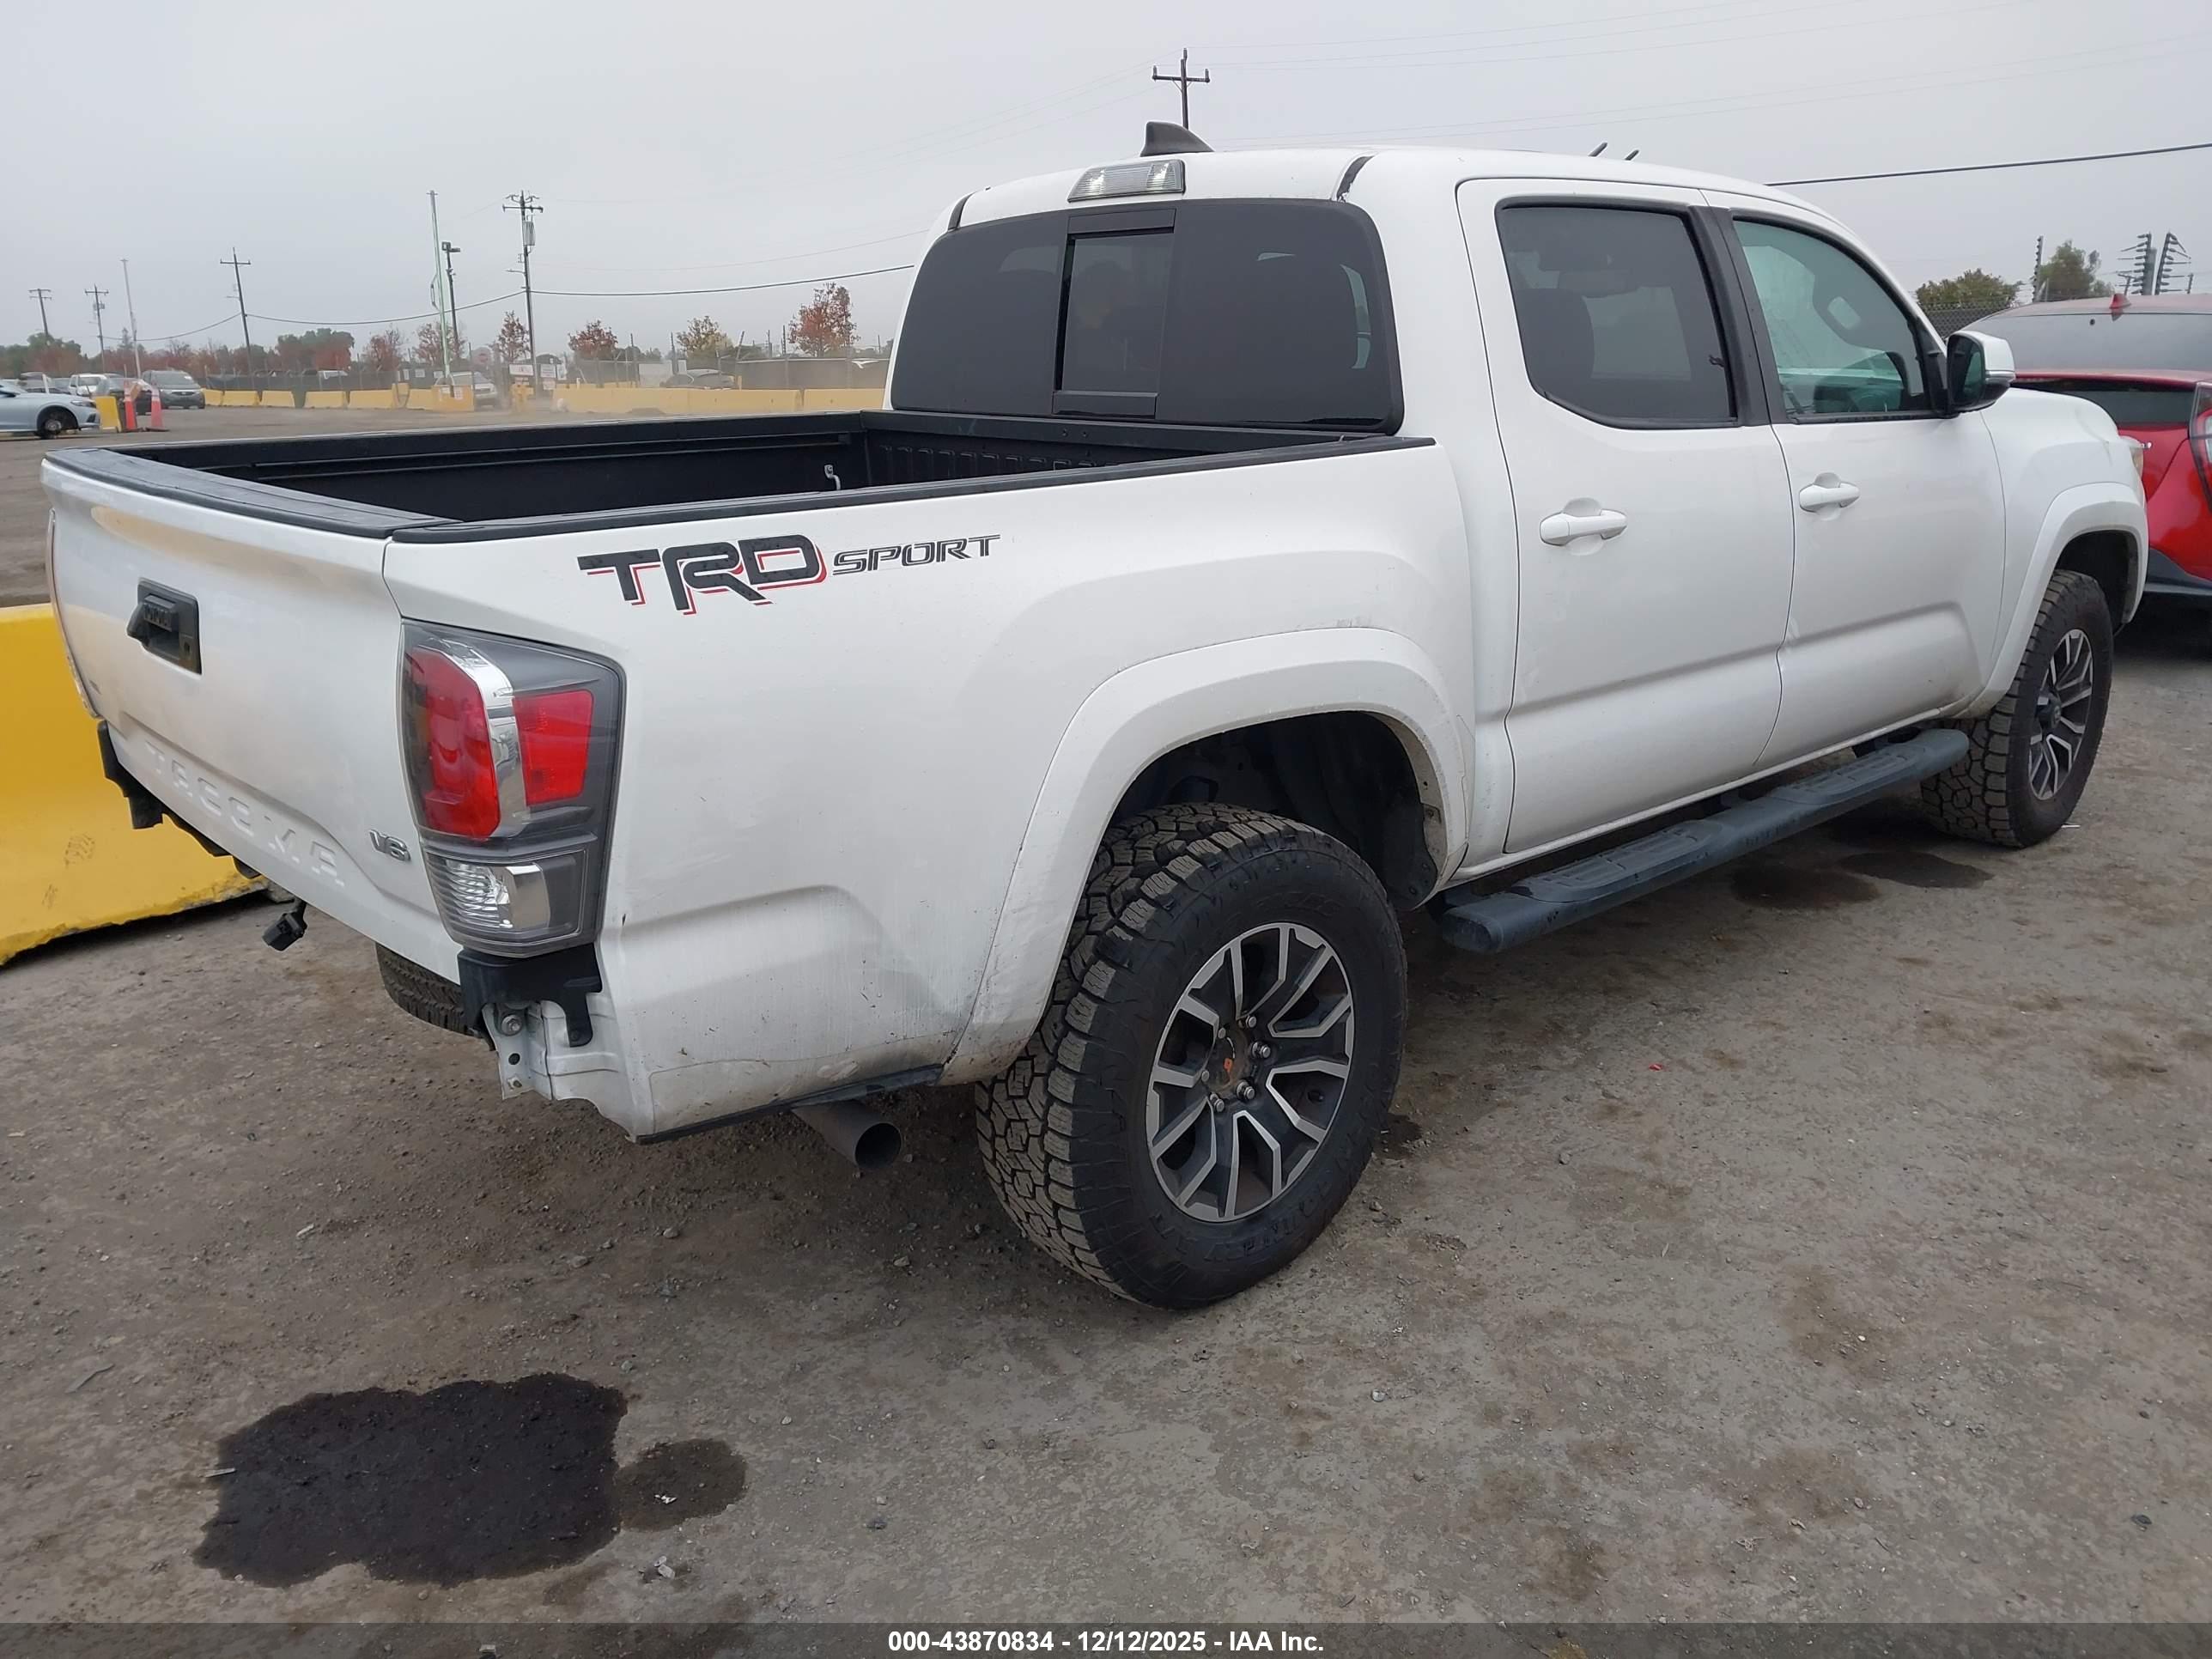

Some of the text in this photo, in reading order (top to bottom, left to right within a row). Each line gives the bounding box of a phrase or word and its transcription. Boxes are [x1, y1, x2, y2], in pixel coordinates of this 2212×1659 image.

[577, 533, 1001, 616] TRD SPORT
[368, 829, 411, 861] V6
